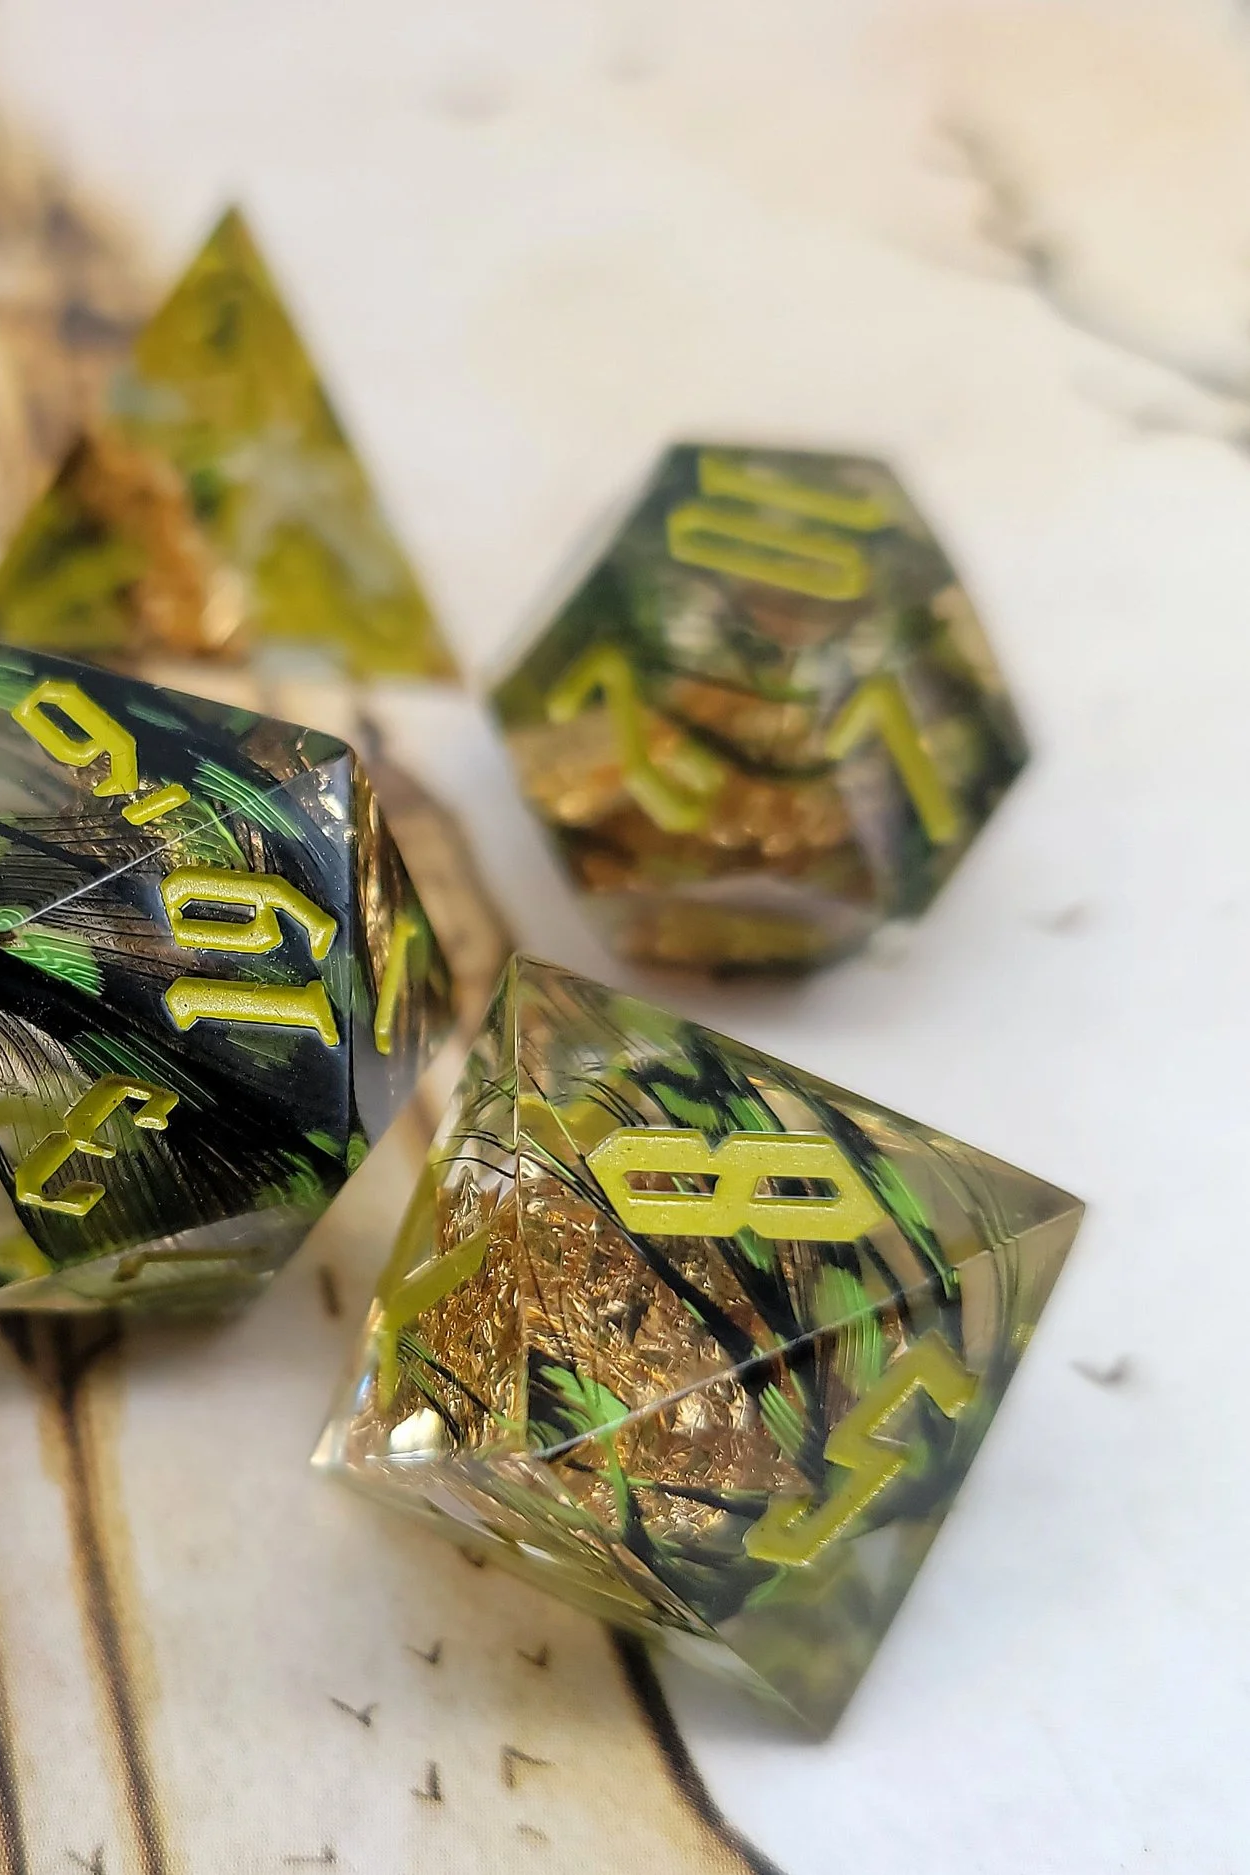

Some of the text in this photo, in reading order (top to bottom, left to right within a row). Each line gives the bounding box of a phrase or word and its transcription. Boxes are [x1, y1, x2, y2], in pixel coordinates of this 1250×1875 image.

[160, 865, 341, 1047] 19
[15, 1072, 180, 1217] 3
[587, 1126, 886, 1242] 8
